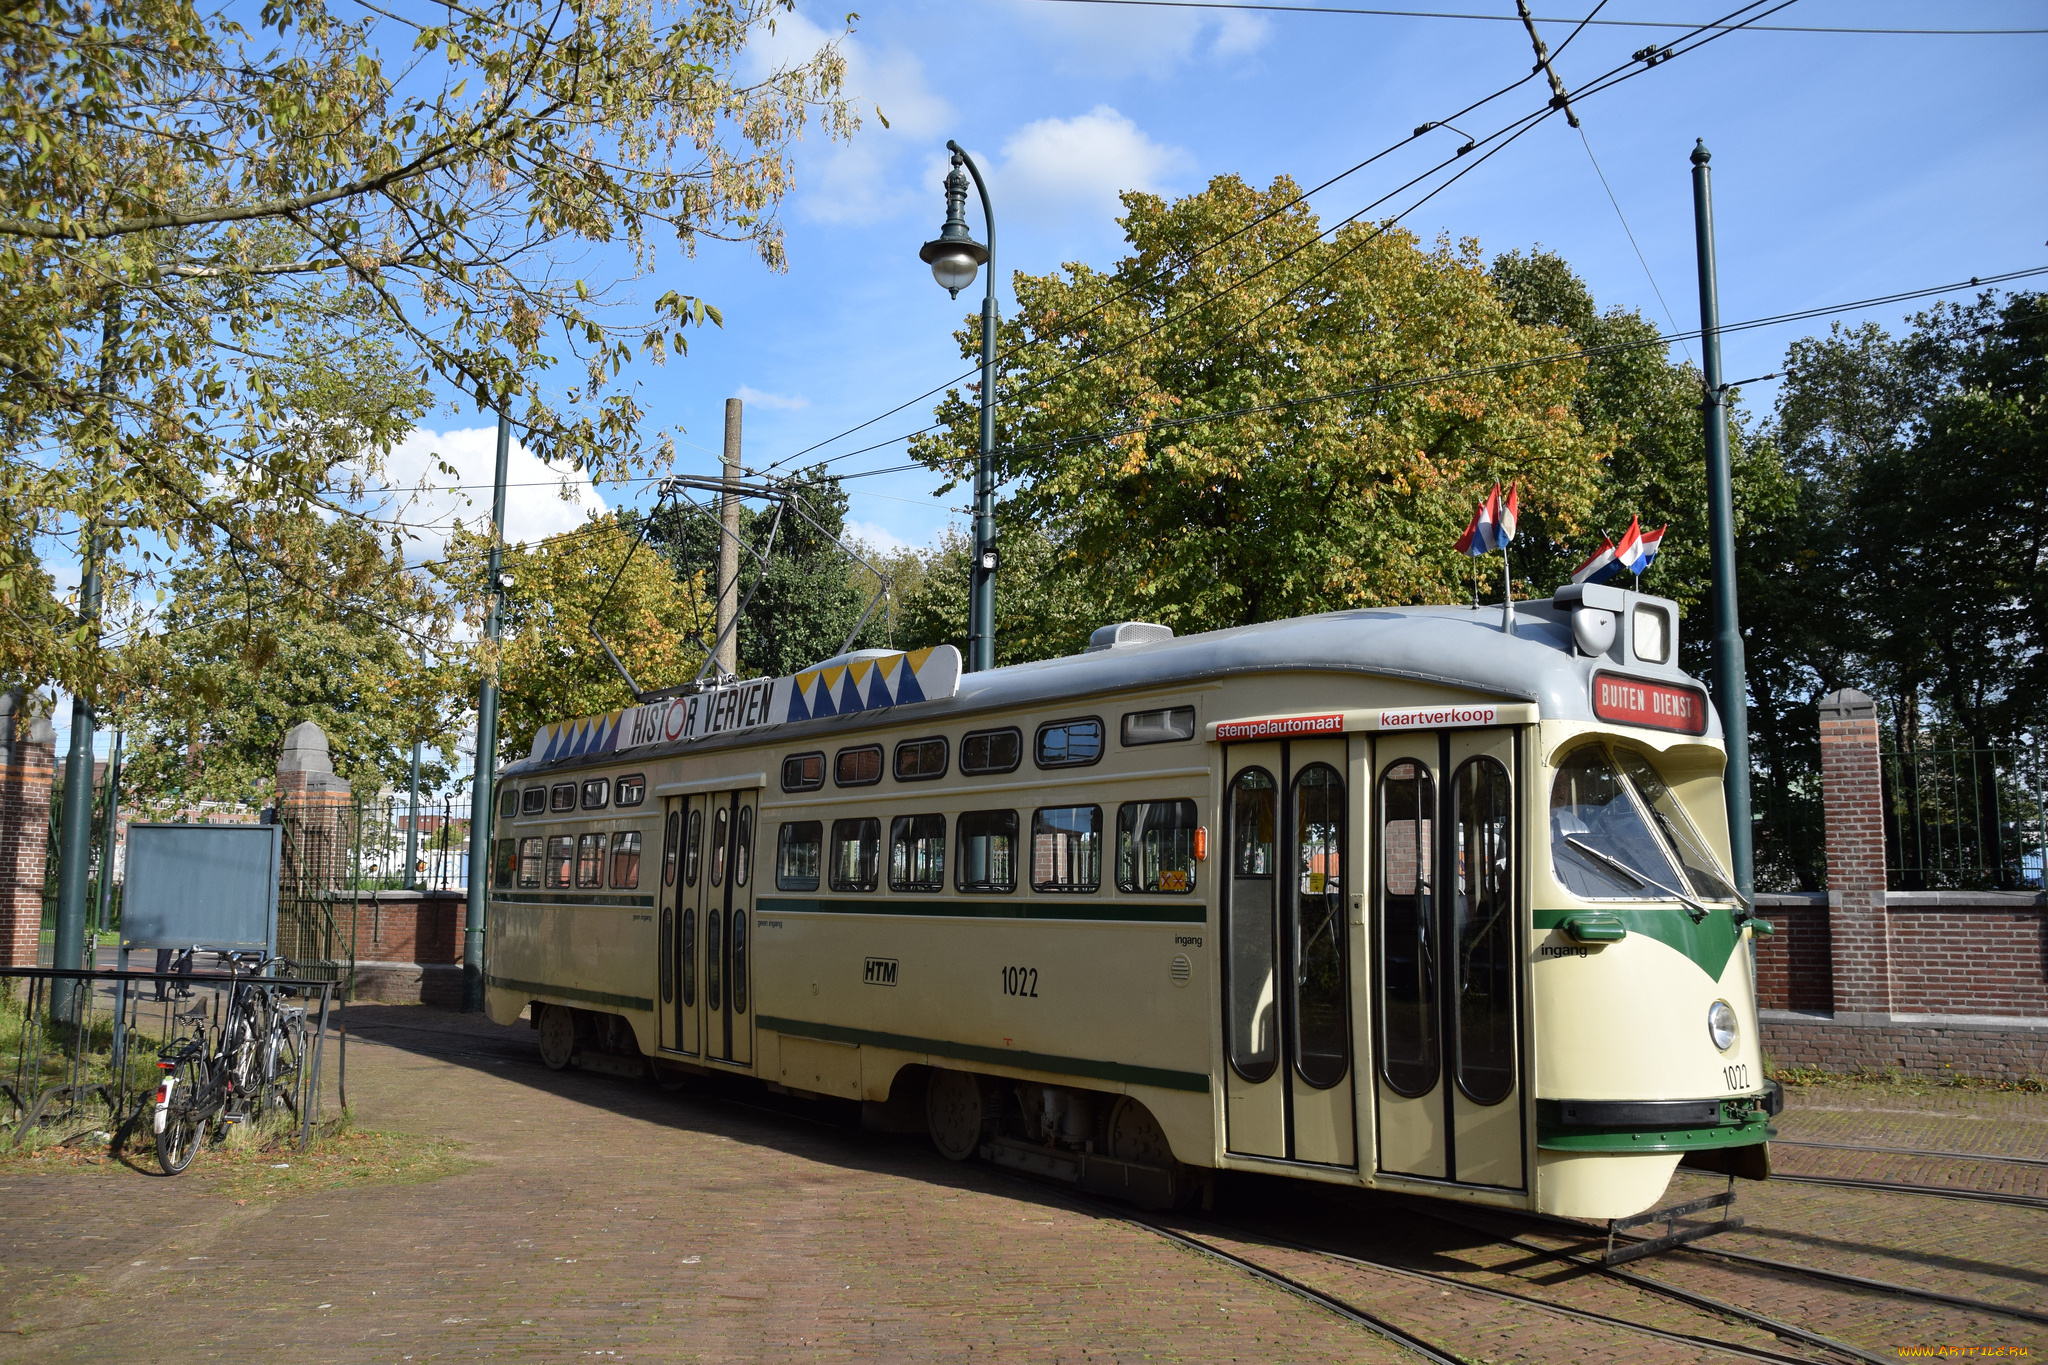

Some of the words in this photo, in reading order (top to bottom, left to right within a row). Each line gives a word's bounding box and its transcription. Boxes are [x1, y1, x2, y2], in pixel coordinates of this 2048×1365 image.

[1602, 683, 1644, 711] BUITEN
[1653, 691, 1692, 718] DIENST
[631, 698, 699, 745] HISTOR
[704, 681, 774, 733] VERVEN
[1381, 707, 1495, 727] kaartverkoop
[1217, 715, 1341, 737] stempelautomaat
[757, 920, 768, 928] geen
[769, 919, 783, 929] ingang
[1174, 933, 1203, 948] ingang
[1541, 943, 1588, 959] ingang
[865, 960, 897, 983] HTM
[1002, 965, 1038, 998] 1022
[1723, 1063, 1750, 1091] 1022
